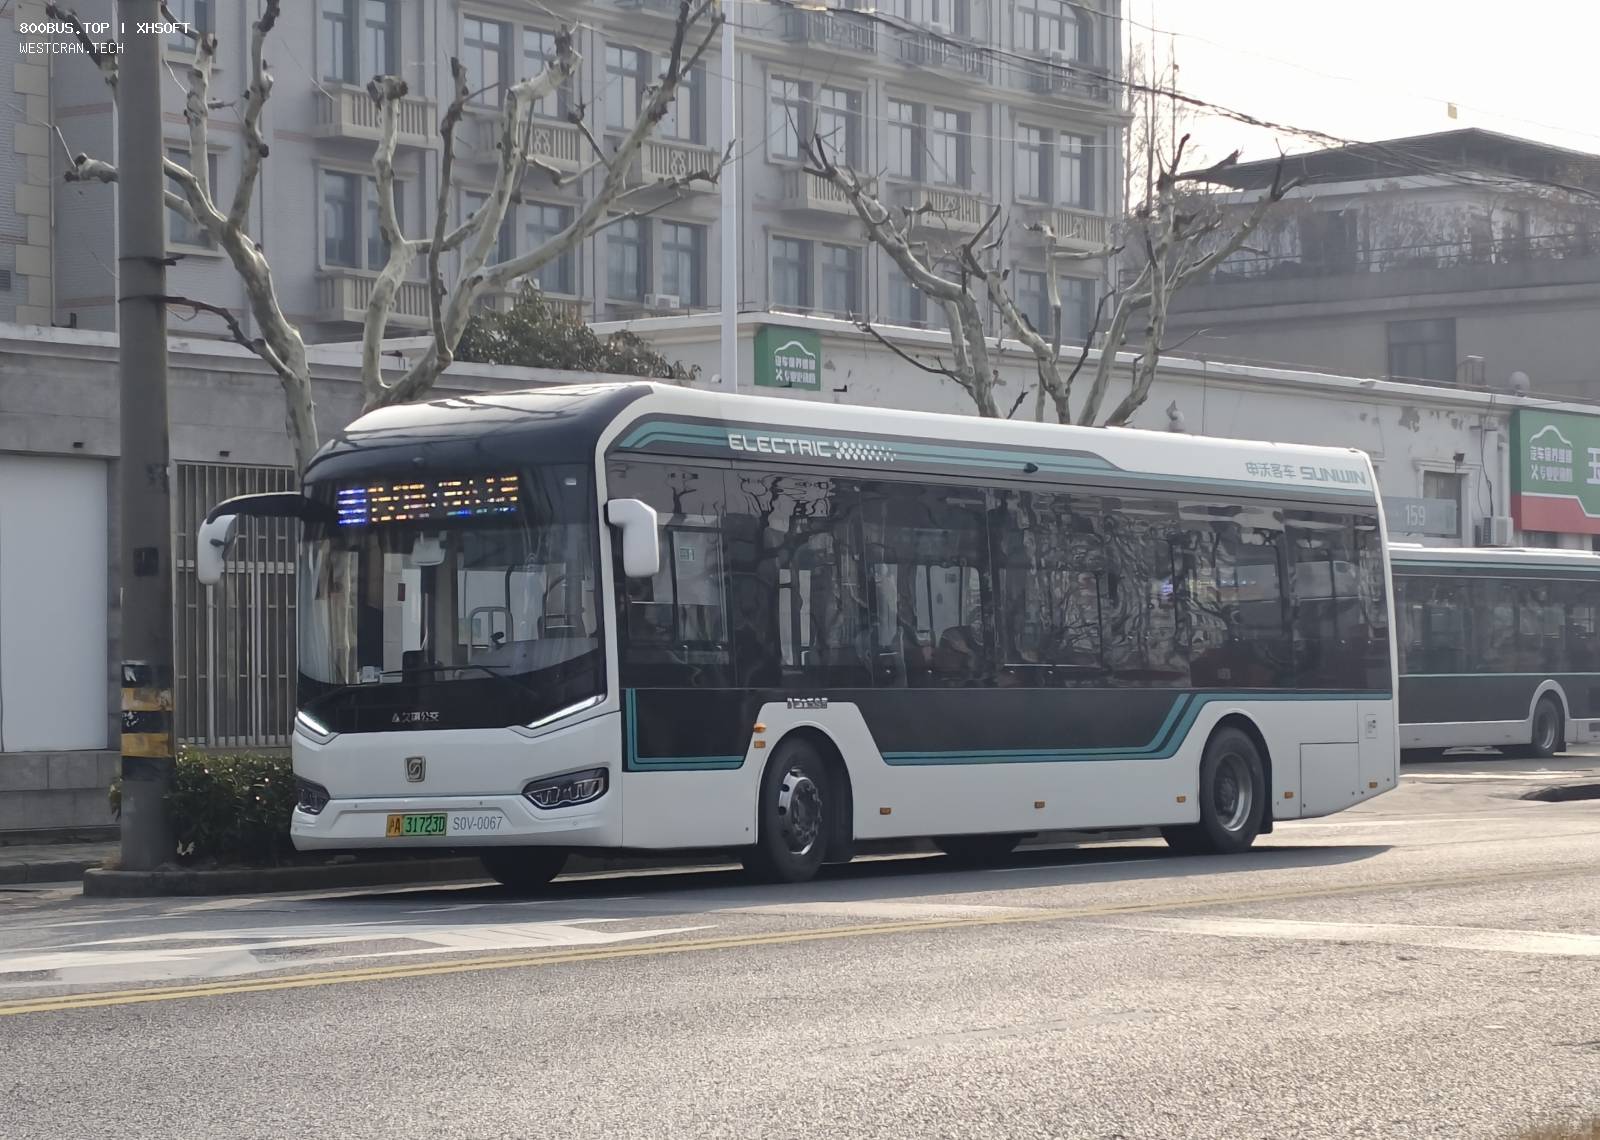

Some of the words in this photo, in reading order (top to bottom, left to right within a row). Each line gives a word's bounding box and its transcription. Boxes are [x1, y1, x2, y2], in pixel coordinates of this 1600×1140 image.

[728, 434, 831, 458] ELECTRIC
[1245, 462, 1297, 478] 申沃客车
[1299, 466, 1366, 484] SUNWIN
[1405, 504, 1425, 526] 159
